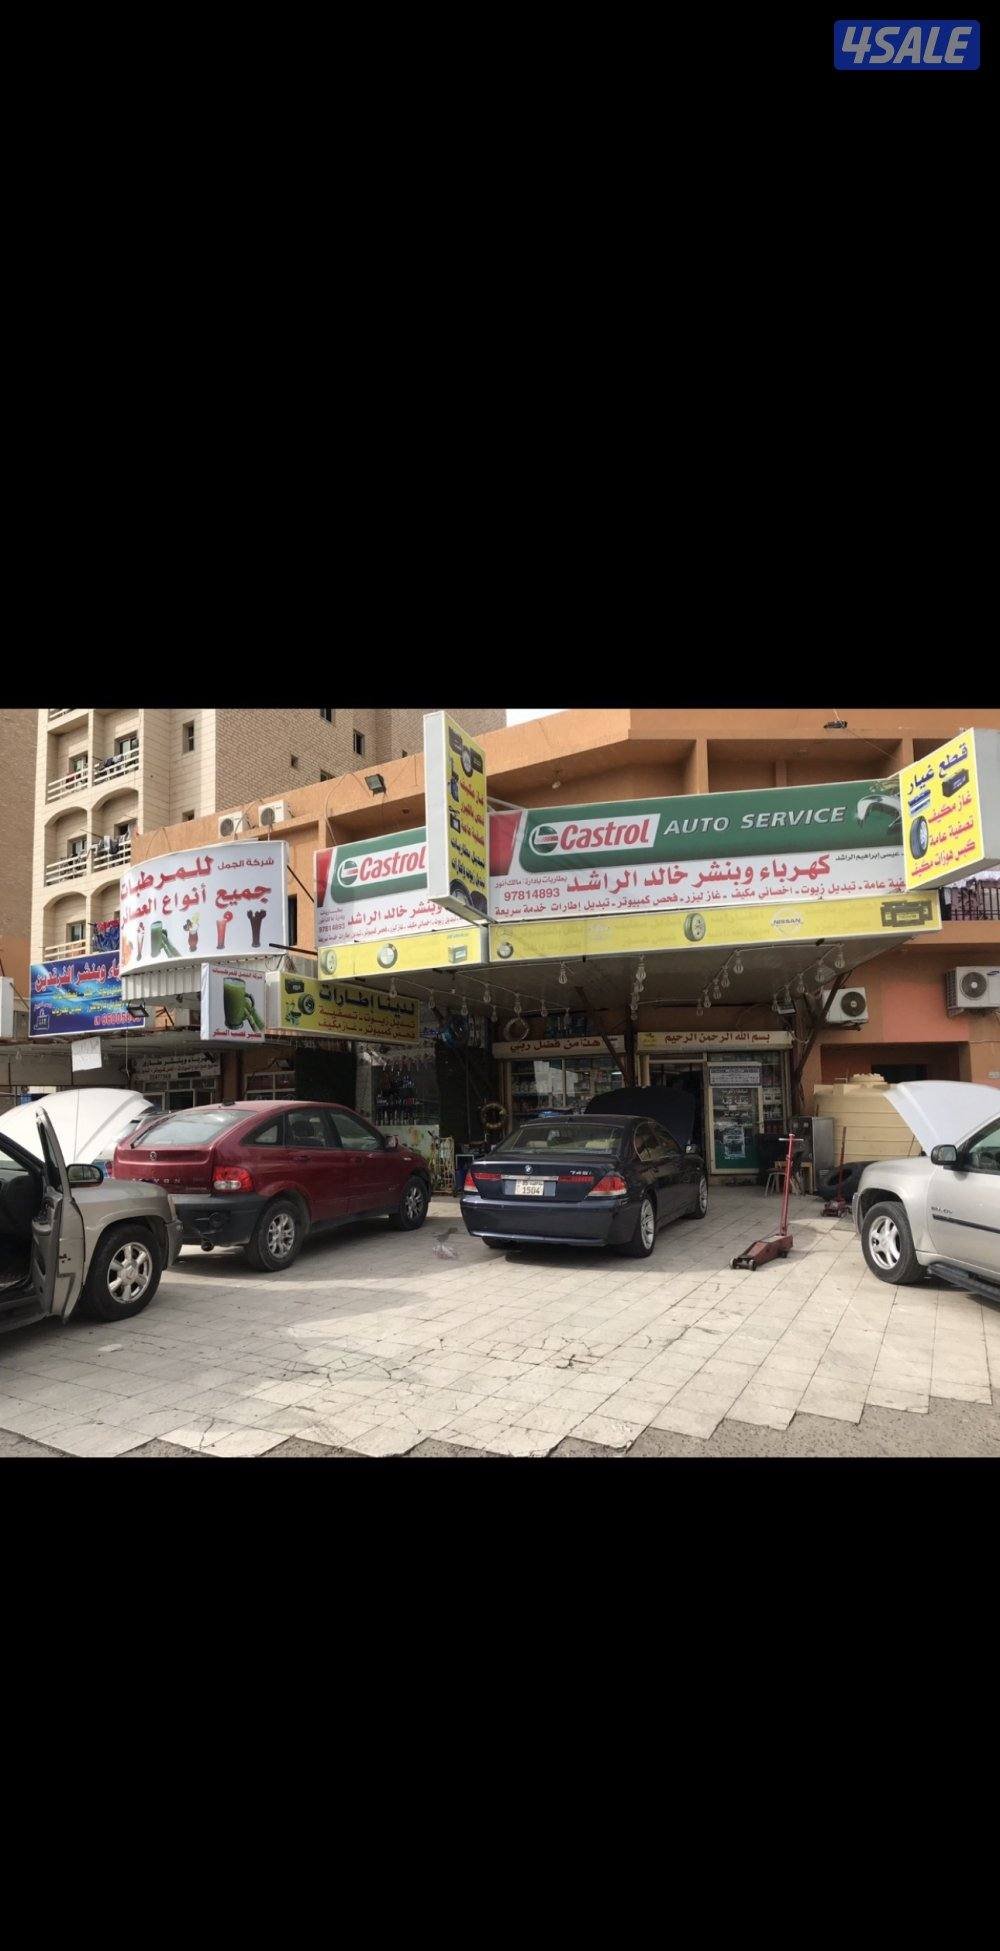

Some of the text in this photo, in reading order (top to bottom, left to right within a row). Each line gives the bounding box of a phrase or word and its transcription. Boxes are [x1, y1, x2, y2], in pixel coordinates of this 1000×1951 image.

[939, 743, 968, 778] قطع
[907, 764, 935, 796] غيار
[928, 802, 956, 824] مكيف
[663, 806, 846, 836] AUTO SERVICE
[560, 818, 650, 850] Castrol
[929, 815, 974, 846] تصفية عامة
[217, 856, 275, 871] شركة الجمل
[359, 845, 427, 882] Castrol
[912, 860, 934, 877] مكيف
[121, 855, 215, 900] للمرطبات
[566, 854, 831, 894] كهرباء وبنشر خالد الراشد
[828, 881, 856, 894] تبديل
[863, 880, 886, 890] عامة
[162, 883, 207, 916] أنواع
[215, 885, 272, 909] جميع
[504, 887, 560, 902] 97814893
[652, 892, 678, 906] فحص
[705, 889, 722, 902] غاز
[731, 888, 756, 900] مكيف
[523, 903, 547, 914] خدمة
[551, 901, 581, 913] إطارات
[584, 901, 610, 911] تبديل
[617, 895, 650, 909] كمبيوتر
[347, 911, 381, 926] الراشد
[384, 904, 408, 920] خالد
[495, 906, 522, 917] سريعة
[772, 917, 802, 927] NISSAN
[319, 984, 374, 1014] إطارات
[563, 1040, 579, 1050] من
[664, 1032, 770, 1045] بسم الله الرحمن الرحيم
[510, 1042, 531, 1052] ربي
